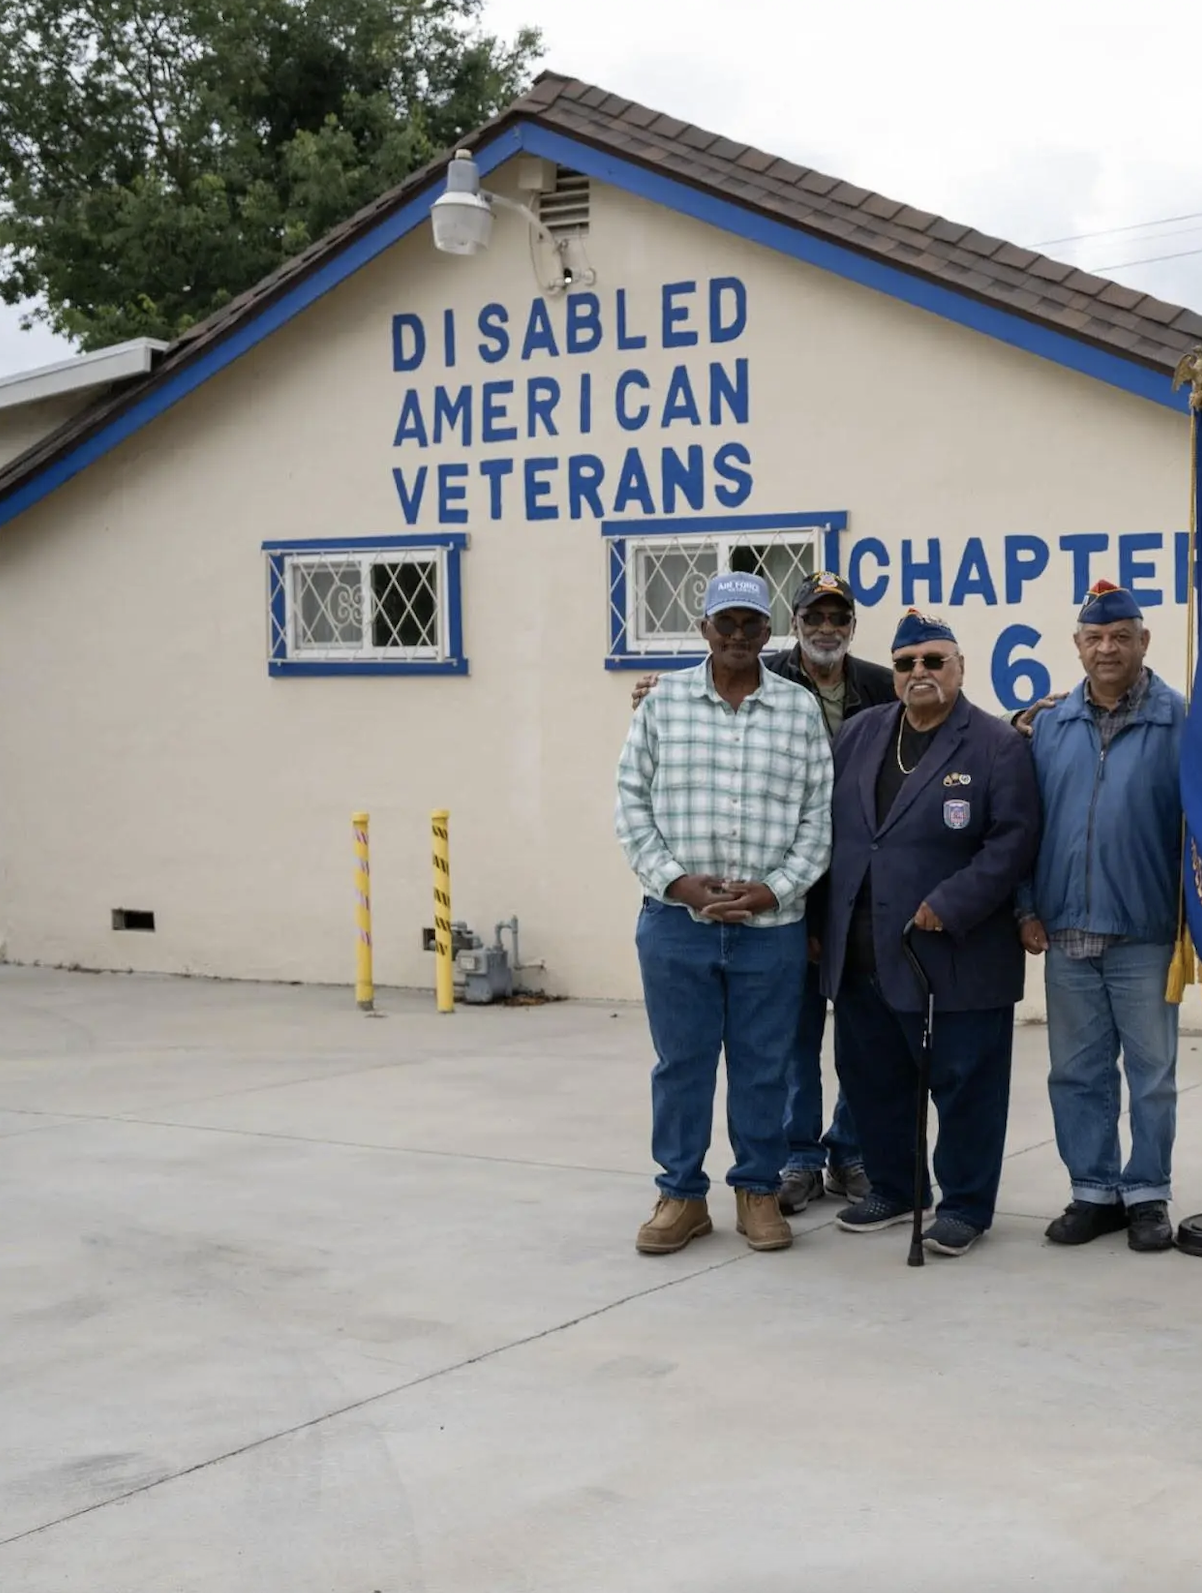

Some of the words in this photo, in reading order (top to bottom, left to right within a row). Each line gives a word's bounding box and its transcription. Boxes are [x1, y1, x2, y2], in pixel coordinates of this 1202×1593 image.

[392, 277, 747, 372] DISABLED
[393, 358, 749, 447] AMERICAN
[392, 442, 753, 524] VETERANS
[991, 624, 1051, 711] 6
